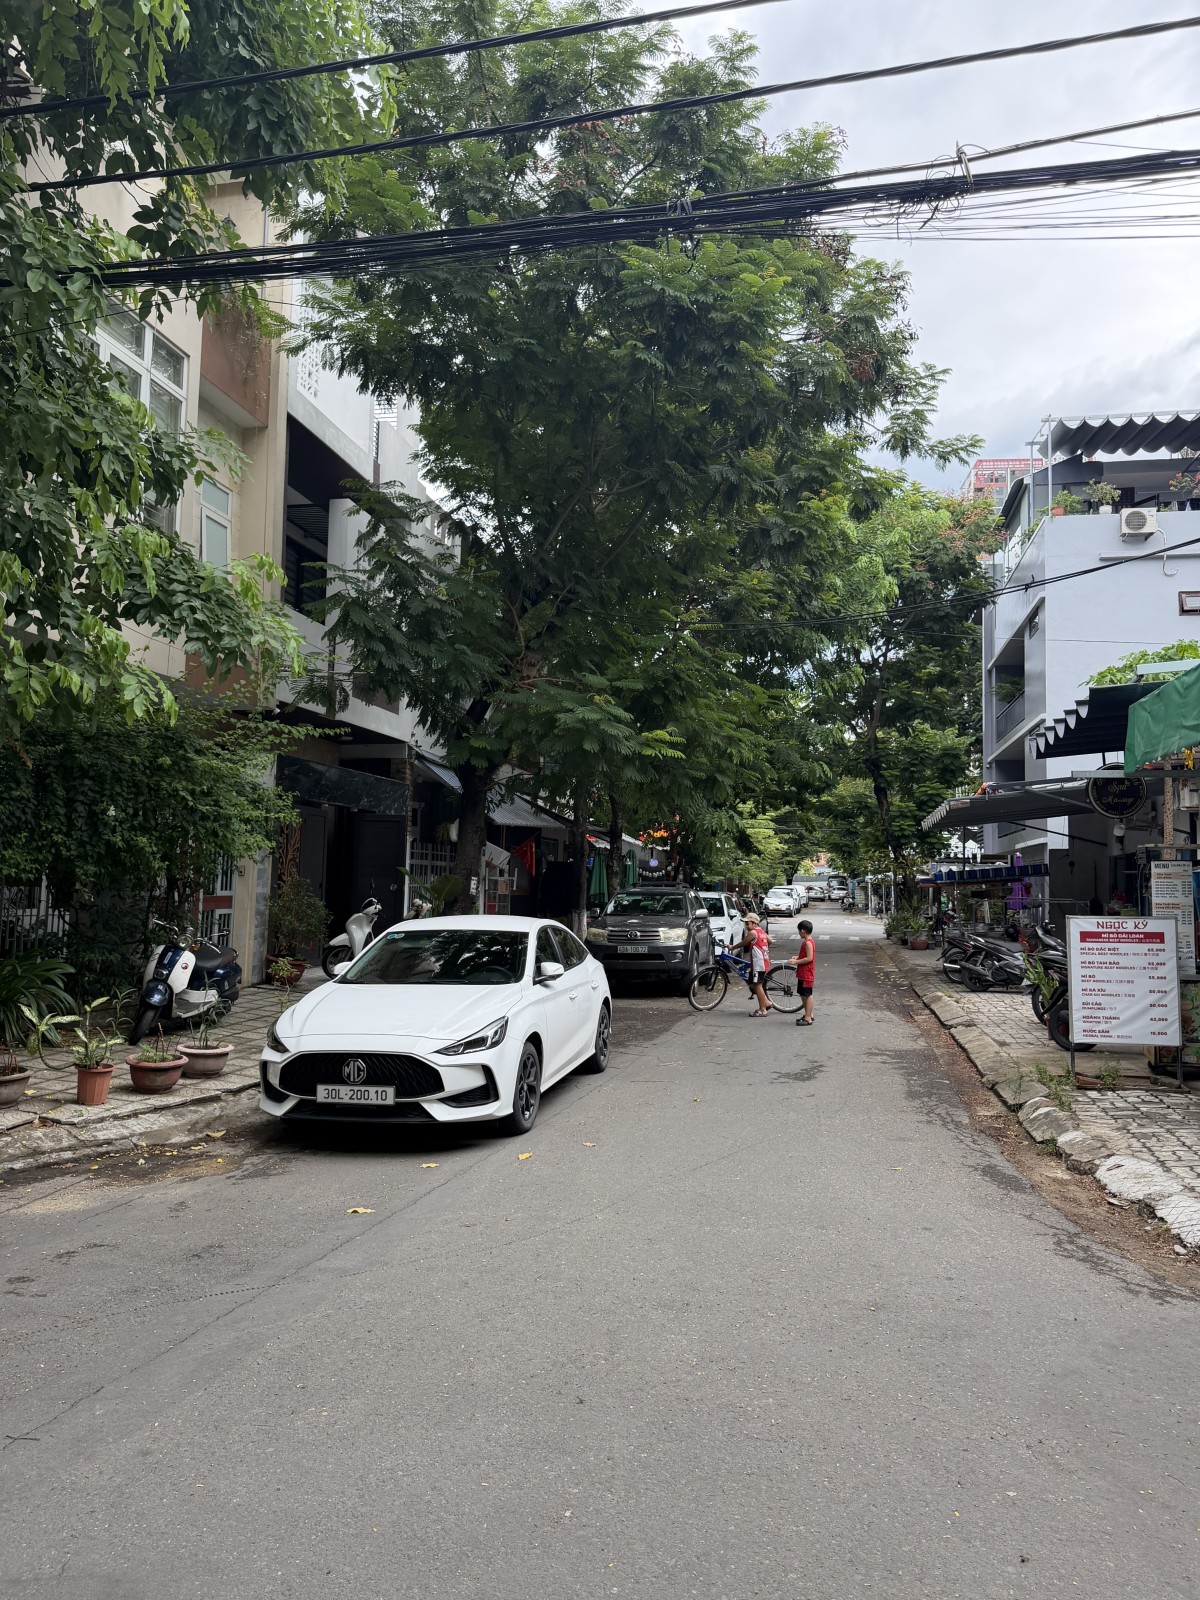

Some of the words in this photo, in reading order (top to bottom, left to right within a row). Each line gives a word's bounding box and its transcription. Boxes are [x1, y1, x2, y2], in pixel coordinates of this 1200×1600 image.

[1096, 921, 1128, 931] NGỌC
[344, 1060, 365, 1083] MG
[324, 1088, 388, 1101] 30L-200.10
